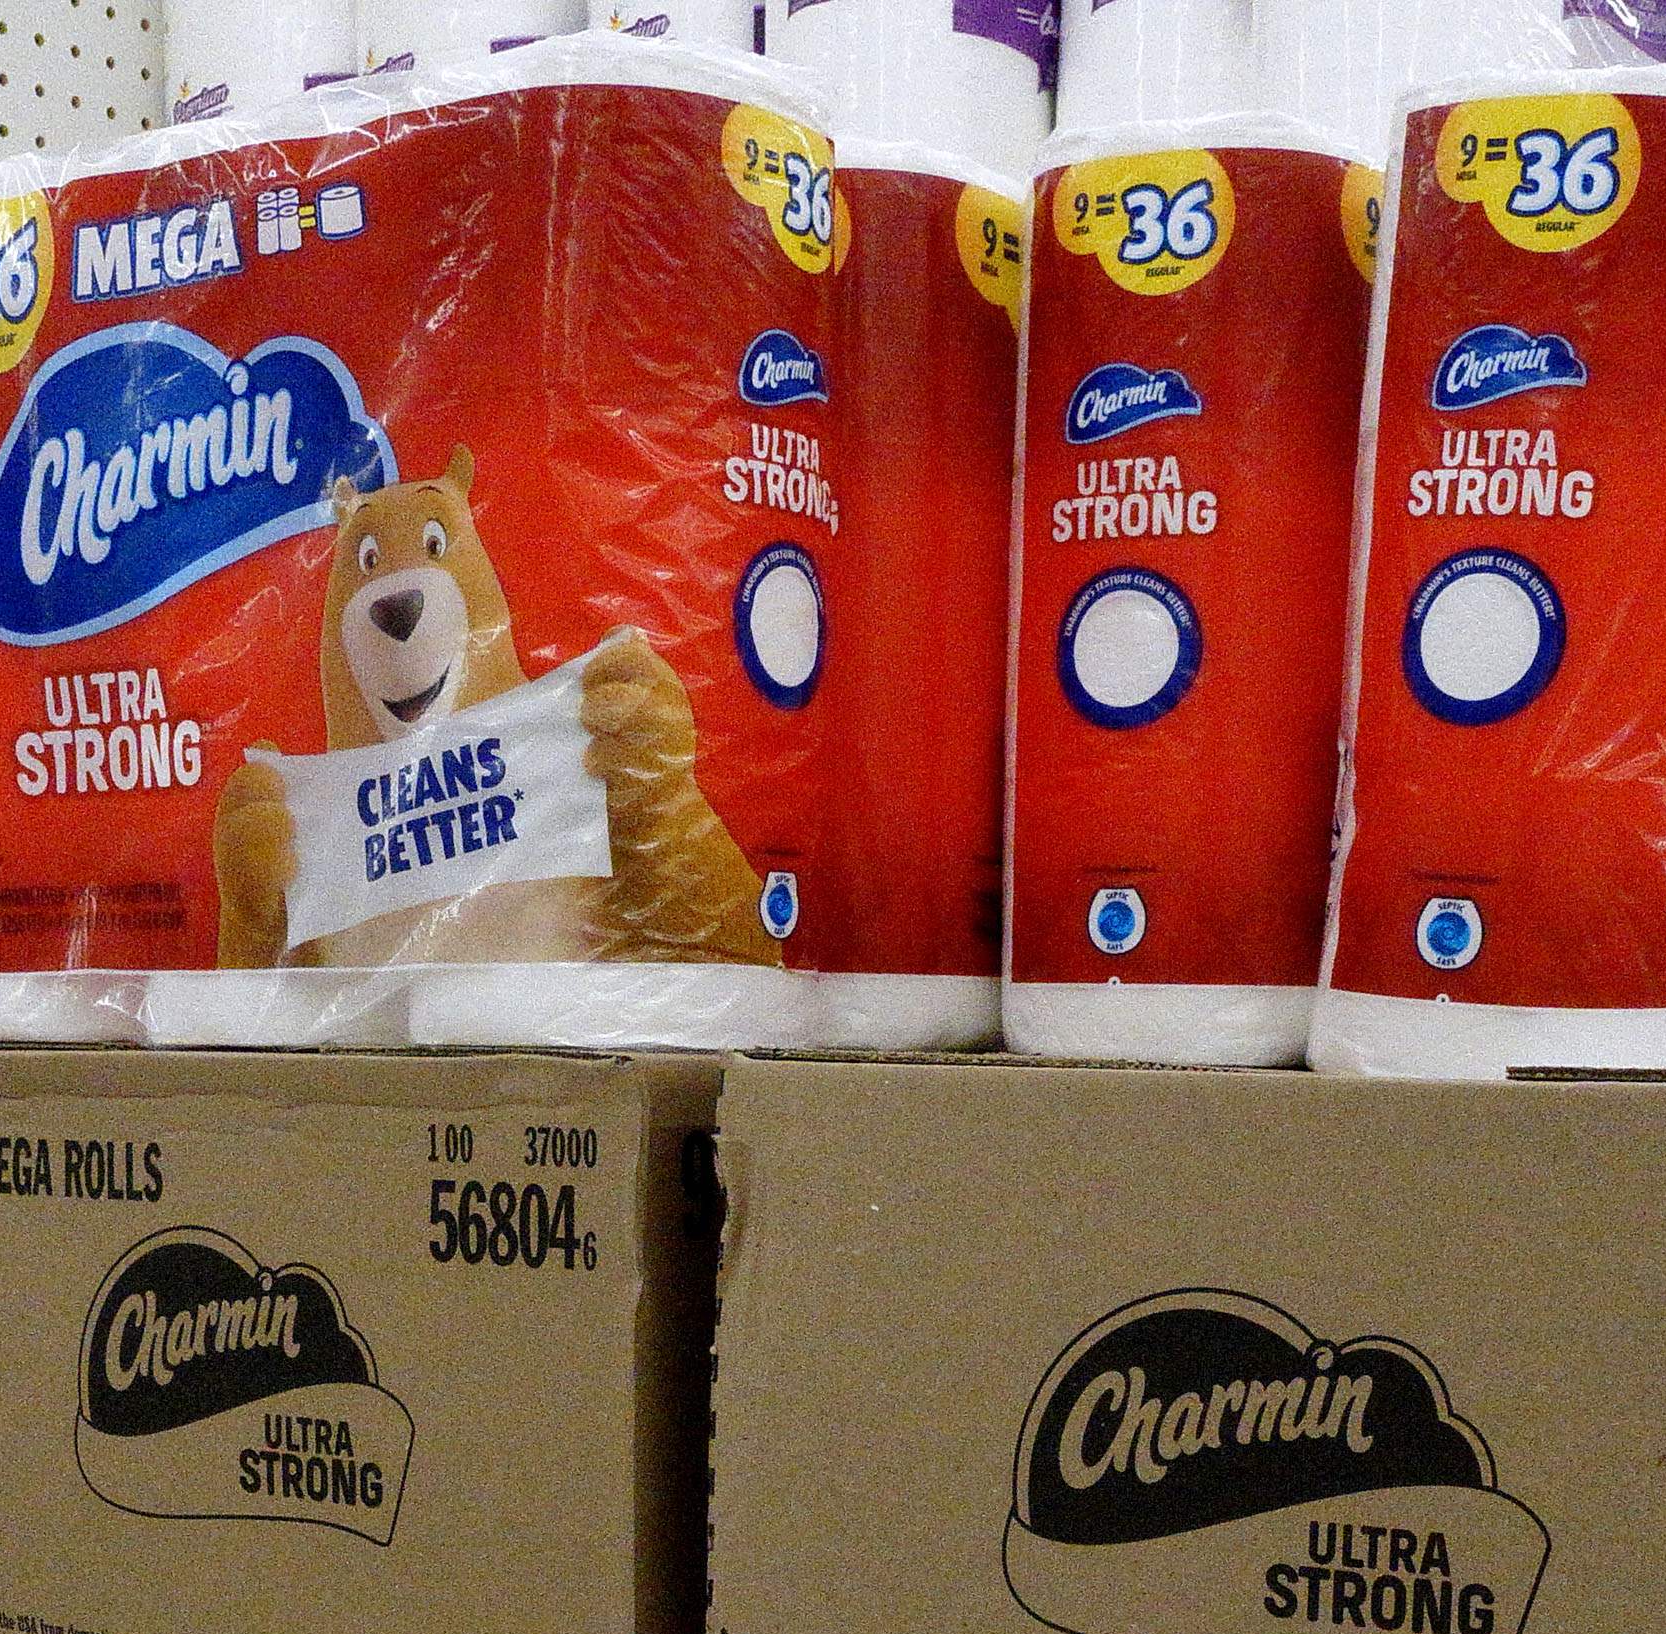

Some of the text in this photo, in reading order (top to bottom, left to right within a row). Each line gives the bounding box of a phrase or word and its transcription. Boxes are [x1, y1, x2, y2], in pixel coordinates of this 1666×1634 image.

[783, 153, 831, 243] 36
[1460, 129, 1619, 214] 9 36
[75, 197, 244, 301] MEGA
[1074, 179, 1214, 264] 9 36
[1446, 335, 1552, 392] Charmin
[1076, 375, 1168, 428] Charmin
[20, 361, 299, 586] Charmin
[751, 423, 819, 473] ULTRA
[1077, 457, 1182, 492] ULTRA
[1441, 430, 1557, 467] ULTRA
[1052, 489, 1217, 542] STRONG
[1408, 468, 1594, 519] STRONG
[1452, 556, 1495, 574] TEXTURE
[1496, 557, 1530, 581] CLEANS
[44, 667, 167, 726] ULTRA
[15, 717, 202, 798] STRONG
[357, 737, 507, 828] CLEANS
[64, 1141, 164, 1203] ROLLS
[524, 1125, 598, 1169] 37000
[104, 1269, 301, 1395] Charmin
[263, 1412, 353, 1457] ULTRA
[1058, 1341, 1375, 1490] Charmin
[238, 1450, 384, 1509] STRONG
[1307, 1520, 1451, 1578] ULTRA
